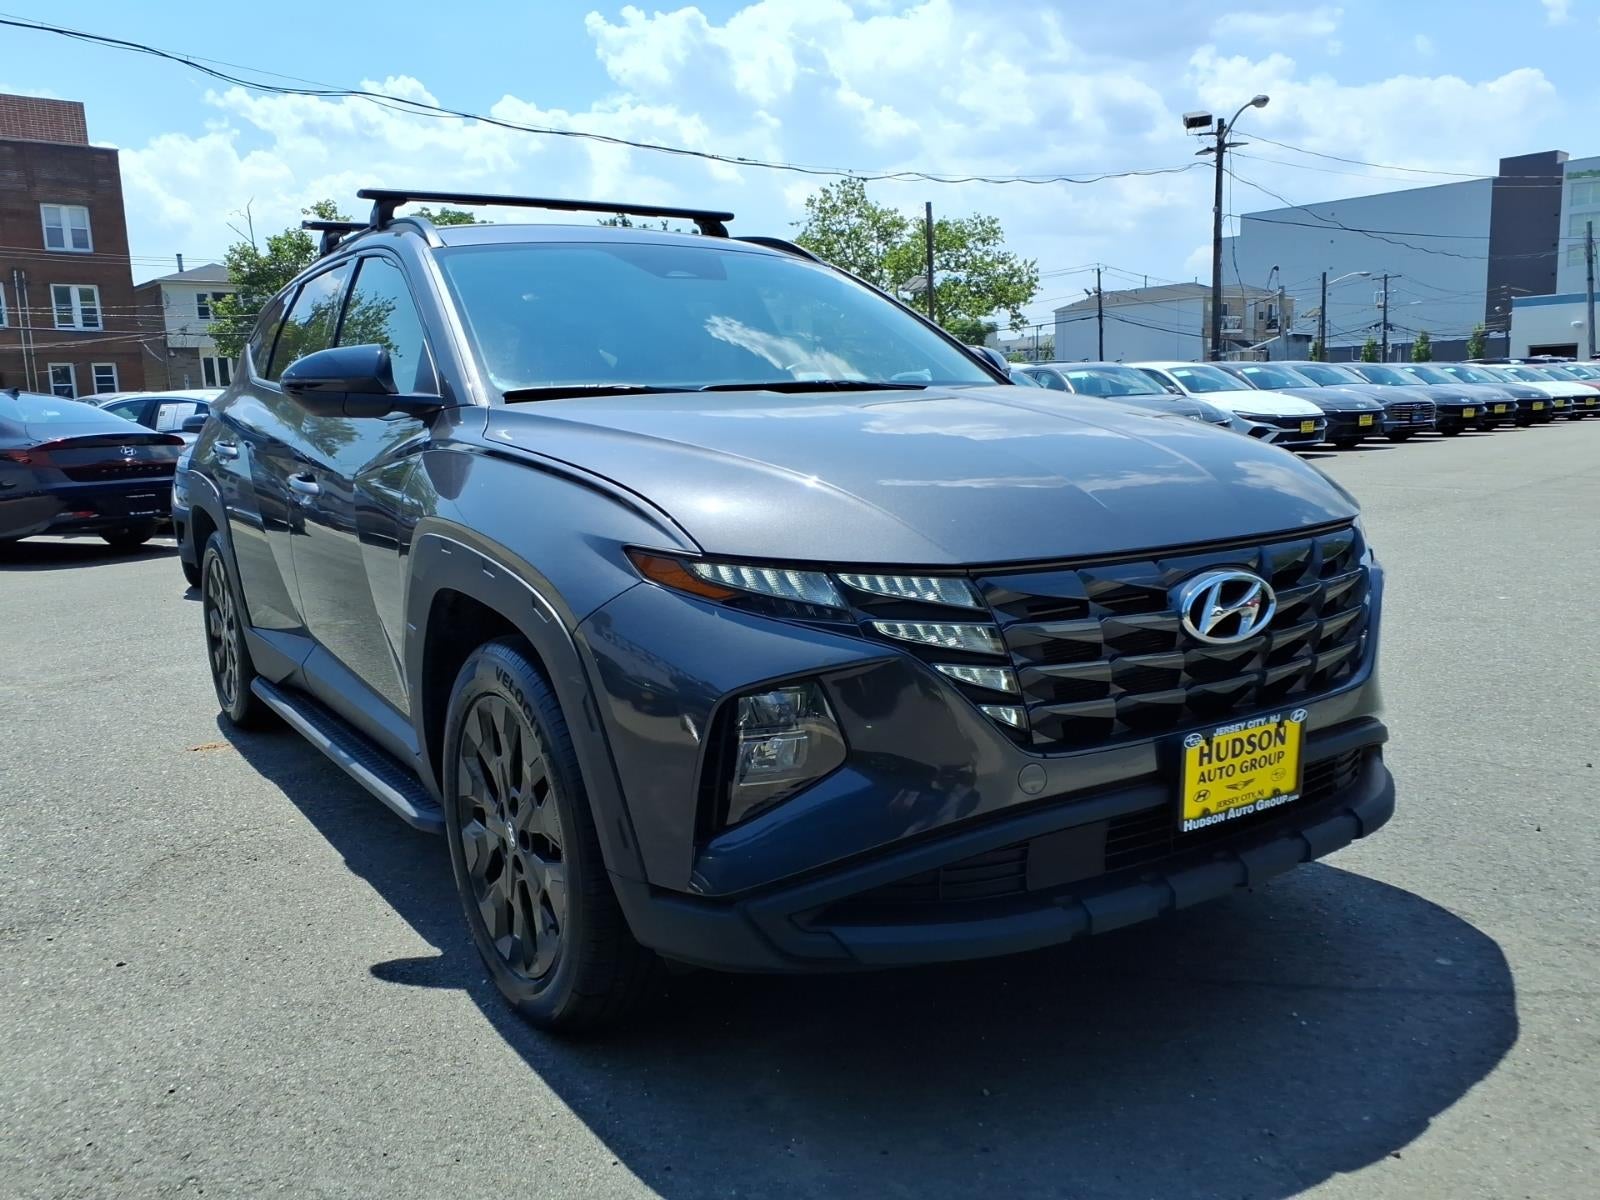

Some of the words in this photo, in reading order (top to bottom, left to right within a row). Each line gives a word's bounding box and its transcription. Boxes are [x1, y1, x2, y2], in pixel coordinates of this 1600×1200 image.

[1214, 722, 1246, 736] JERSEY
[1270, 713, 1281, 723] NJ
[1198, 725, 1287, 767] HUDSON
[1197, 764, 1236, 785] AUTO
[1240, 751, 1285, 773] GROUP
[1217, 798, 1239, 808] JERSEY
